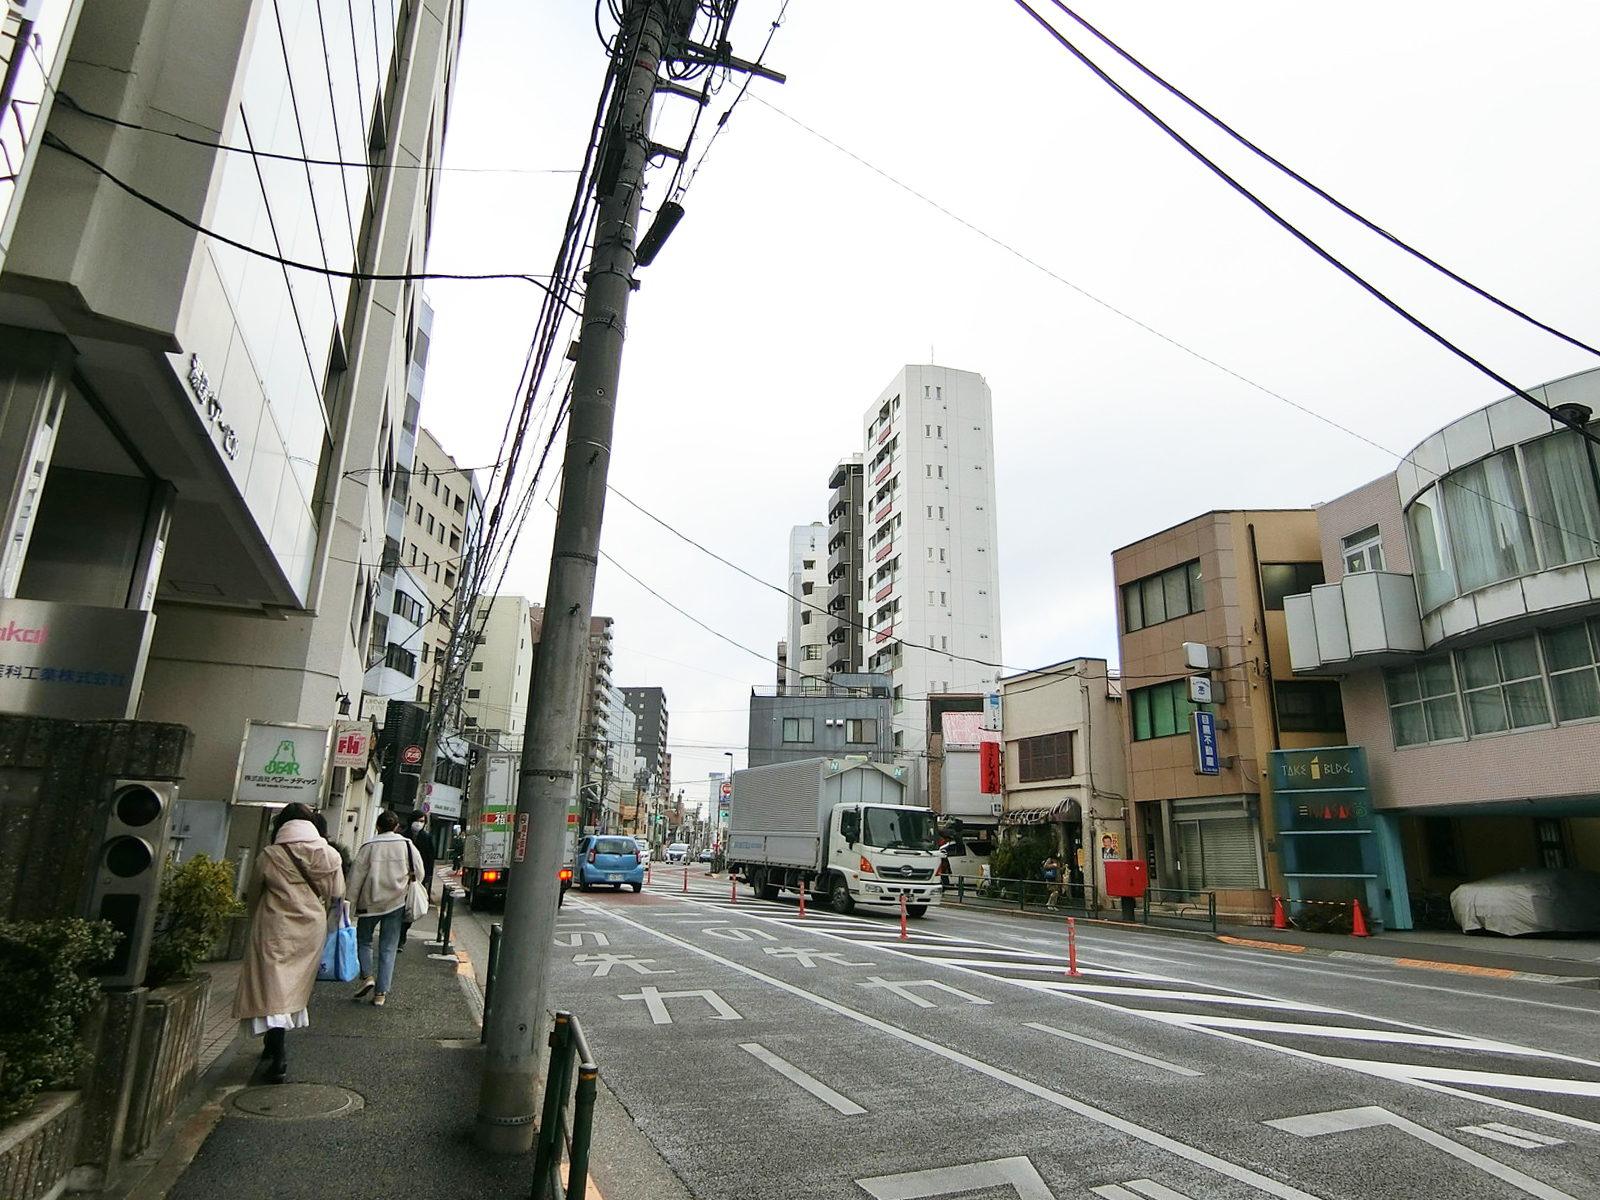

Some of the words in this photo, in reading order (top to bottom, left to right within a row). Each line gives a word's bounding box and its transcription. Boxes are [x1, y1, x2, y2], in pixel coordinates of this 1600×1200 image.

[264, 761, 300, 775] BEAR
[1282, 765, 1307, 776] TAKE
[494, 811, 507, 825] 福
